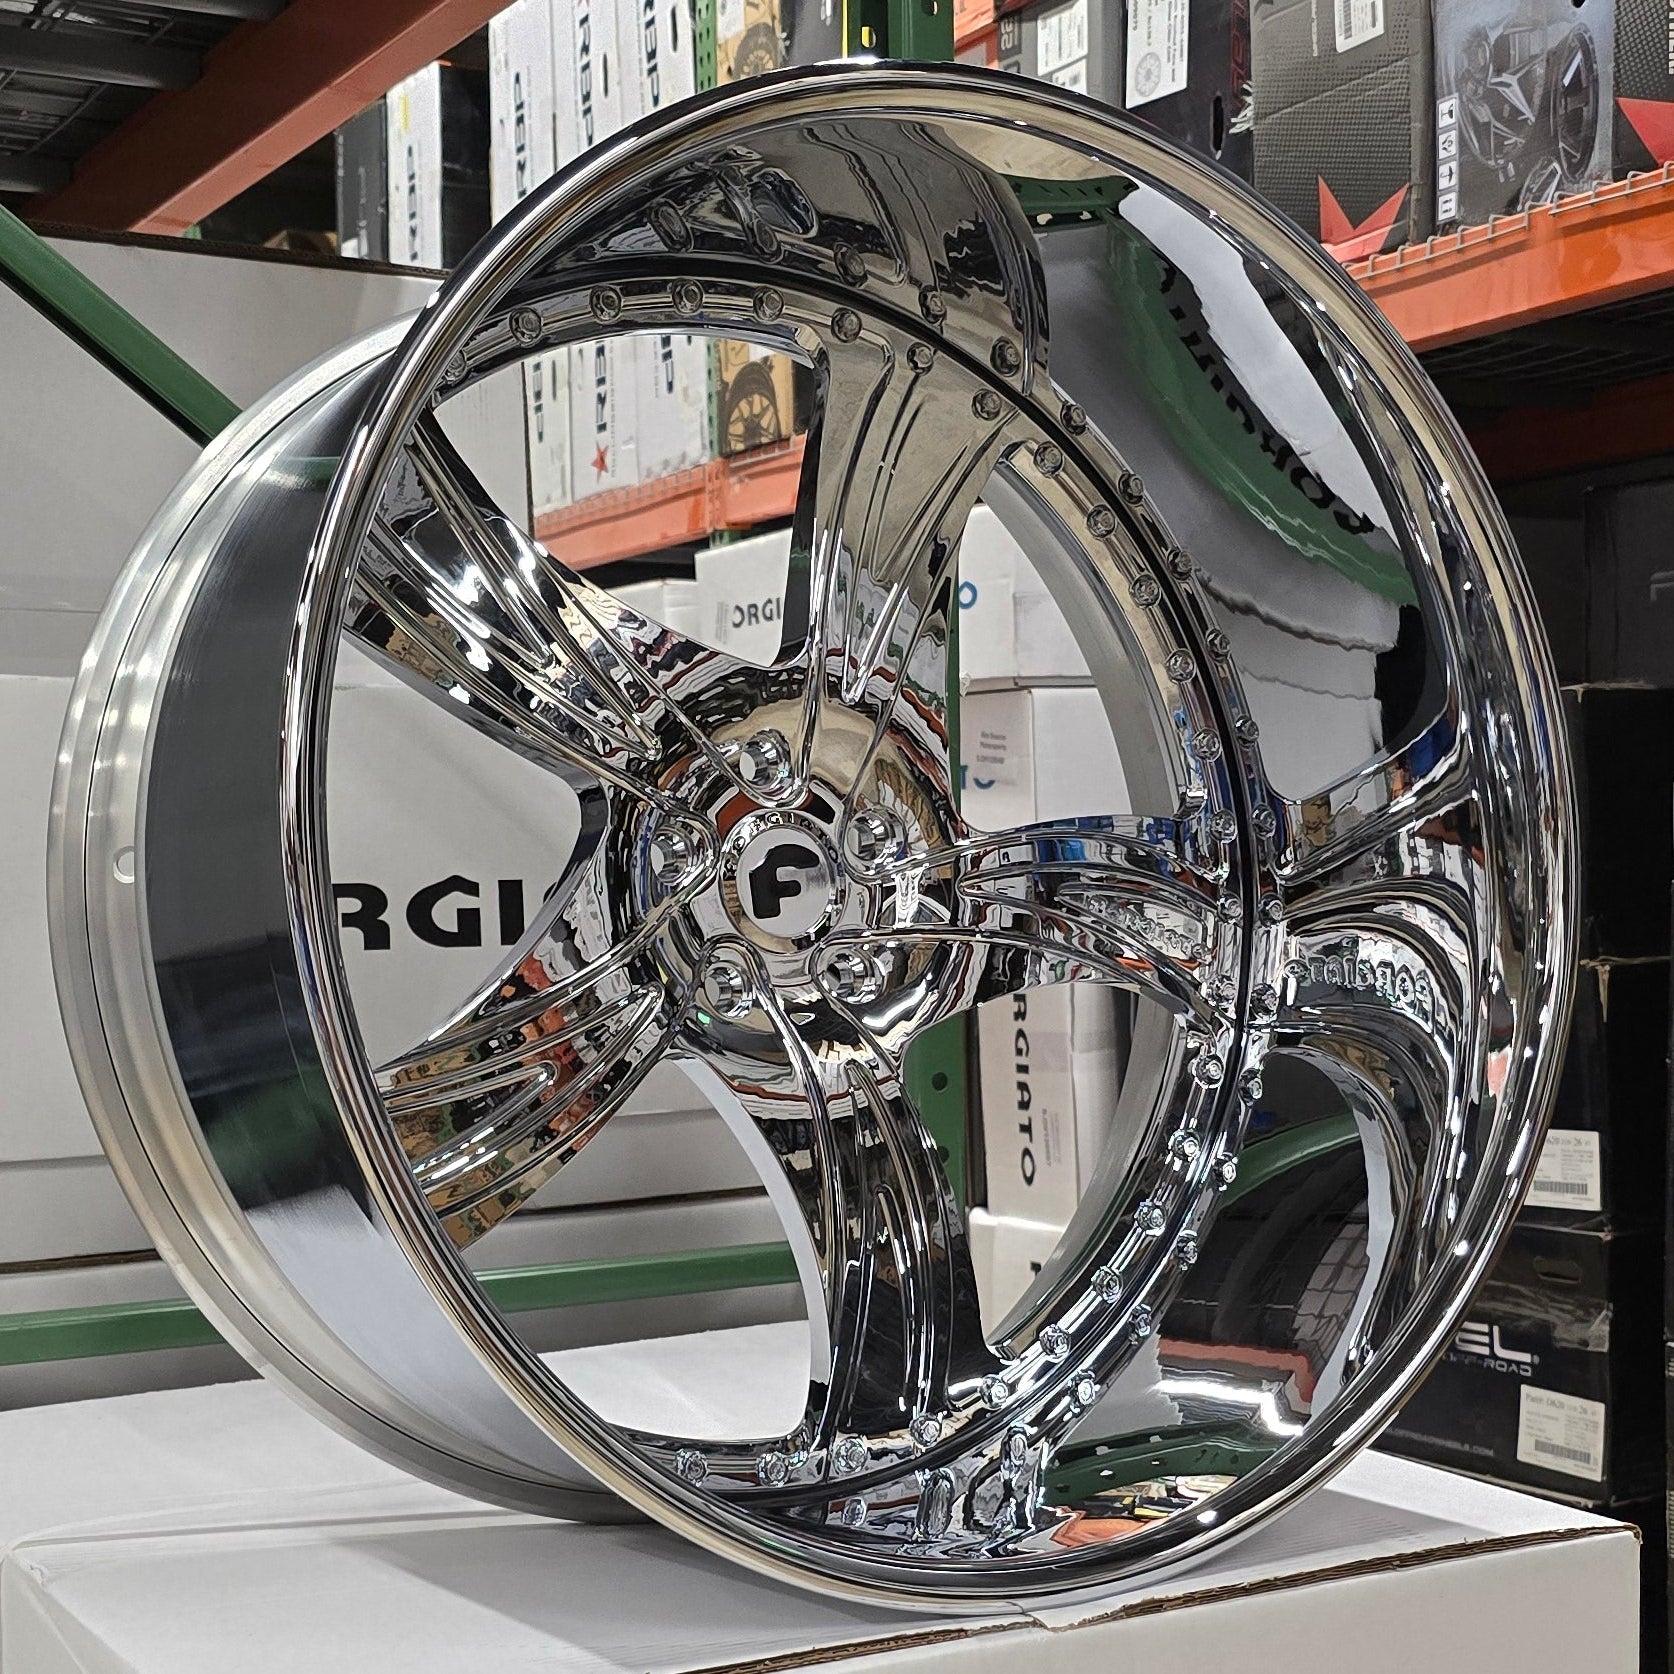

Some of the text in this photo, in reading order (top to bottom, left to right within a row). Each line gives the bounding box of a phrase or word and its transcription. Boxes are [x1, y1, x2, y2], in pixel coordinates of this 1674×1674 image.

[595, 339, 608, 434] RB
[332, 874, 556, 950] RGI
[1012, 993, 1037, 1187] RGIATO
